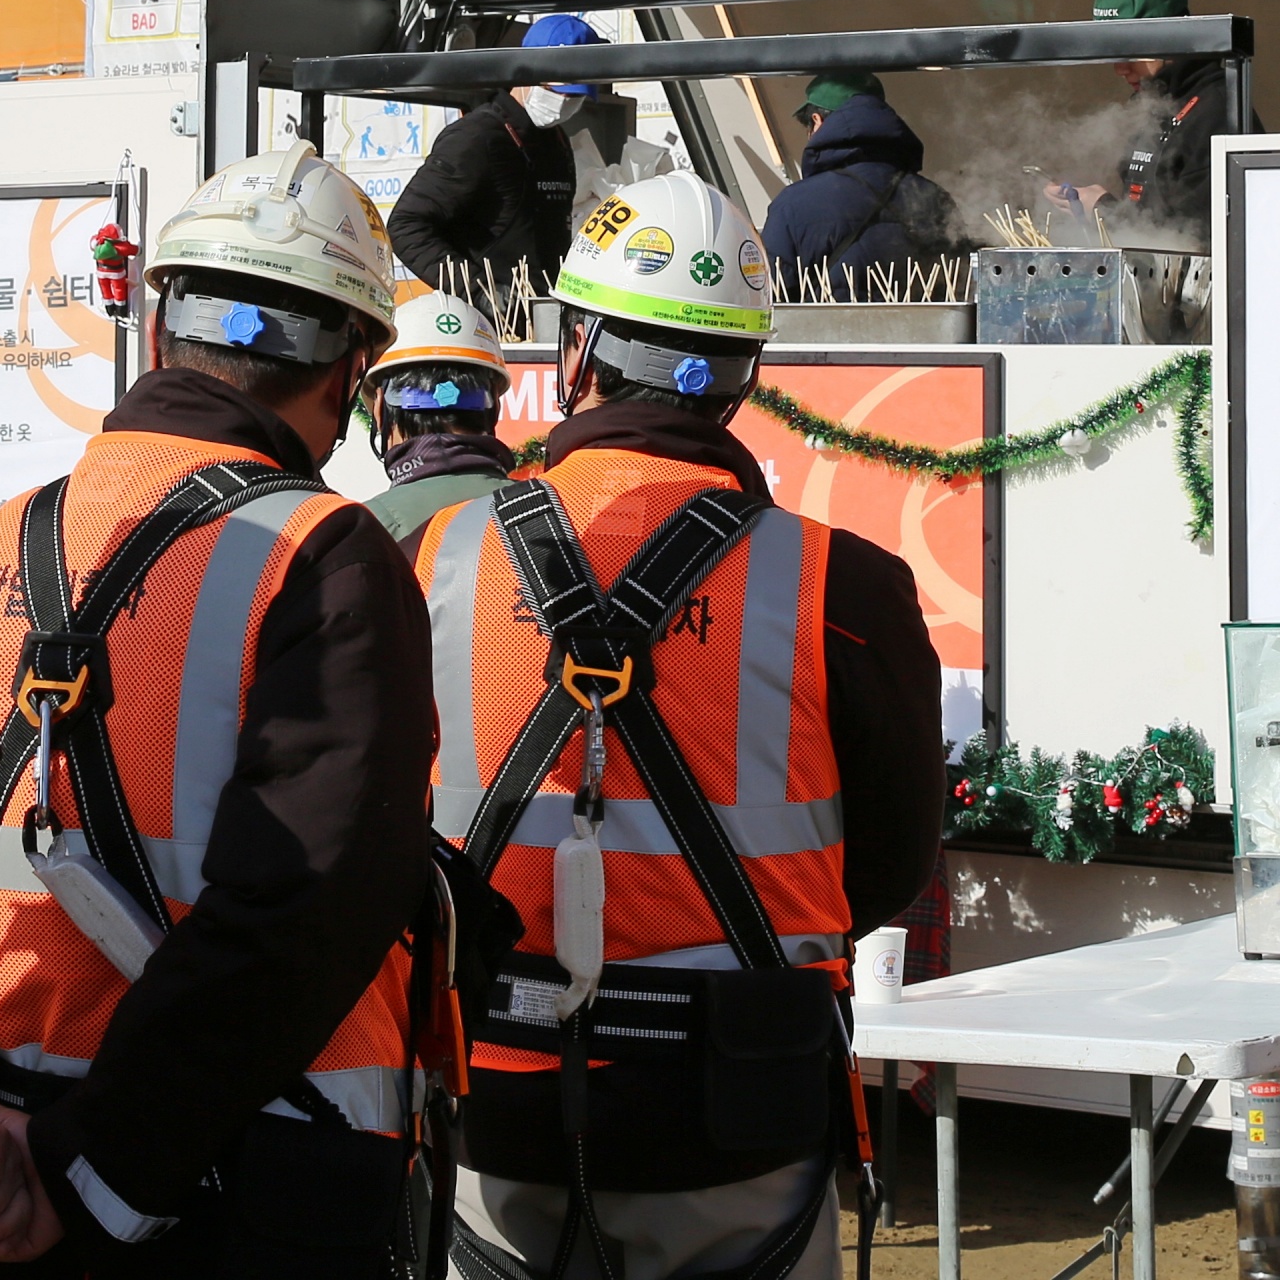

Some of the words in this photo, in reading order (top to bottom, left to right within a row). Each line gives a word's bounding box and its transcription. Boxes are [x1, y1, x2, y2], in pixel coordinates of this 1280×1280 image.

[131, 13, 157, 31] BAD
[365, 177, 401, 197] GOOD
[42, 272, 95, 307] 쉼터
[20, 328, 36, 347] 시
[2, 351, 73, 371] 유의하세요
[16, 422, 32, 442] 옷
